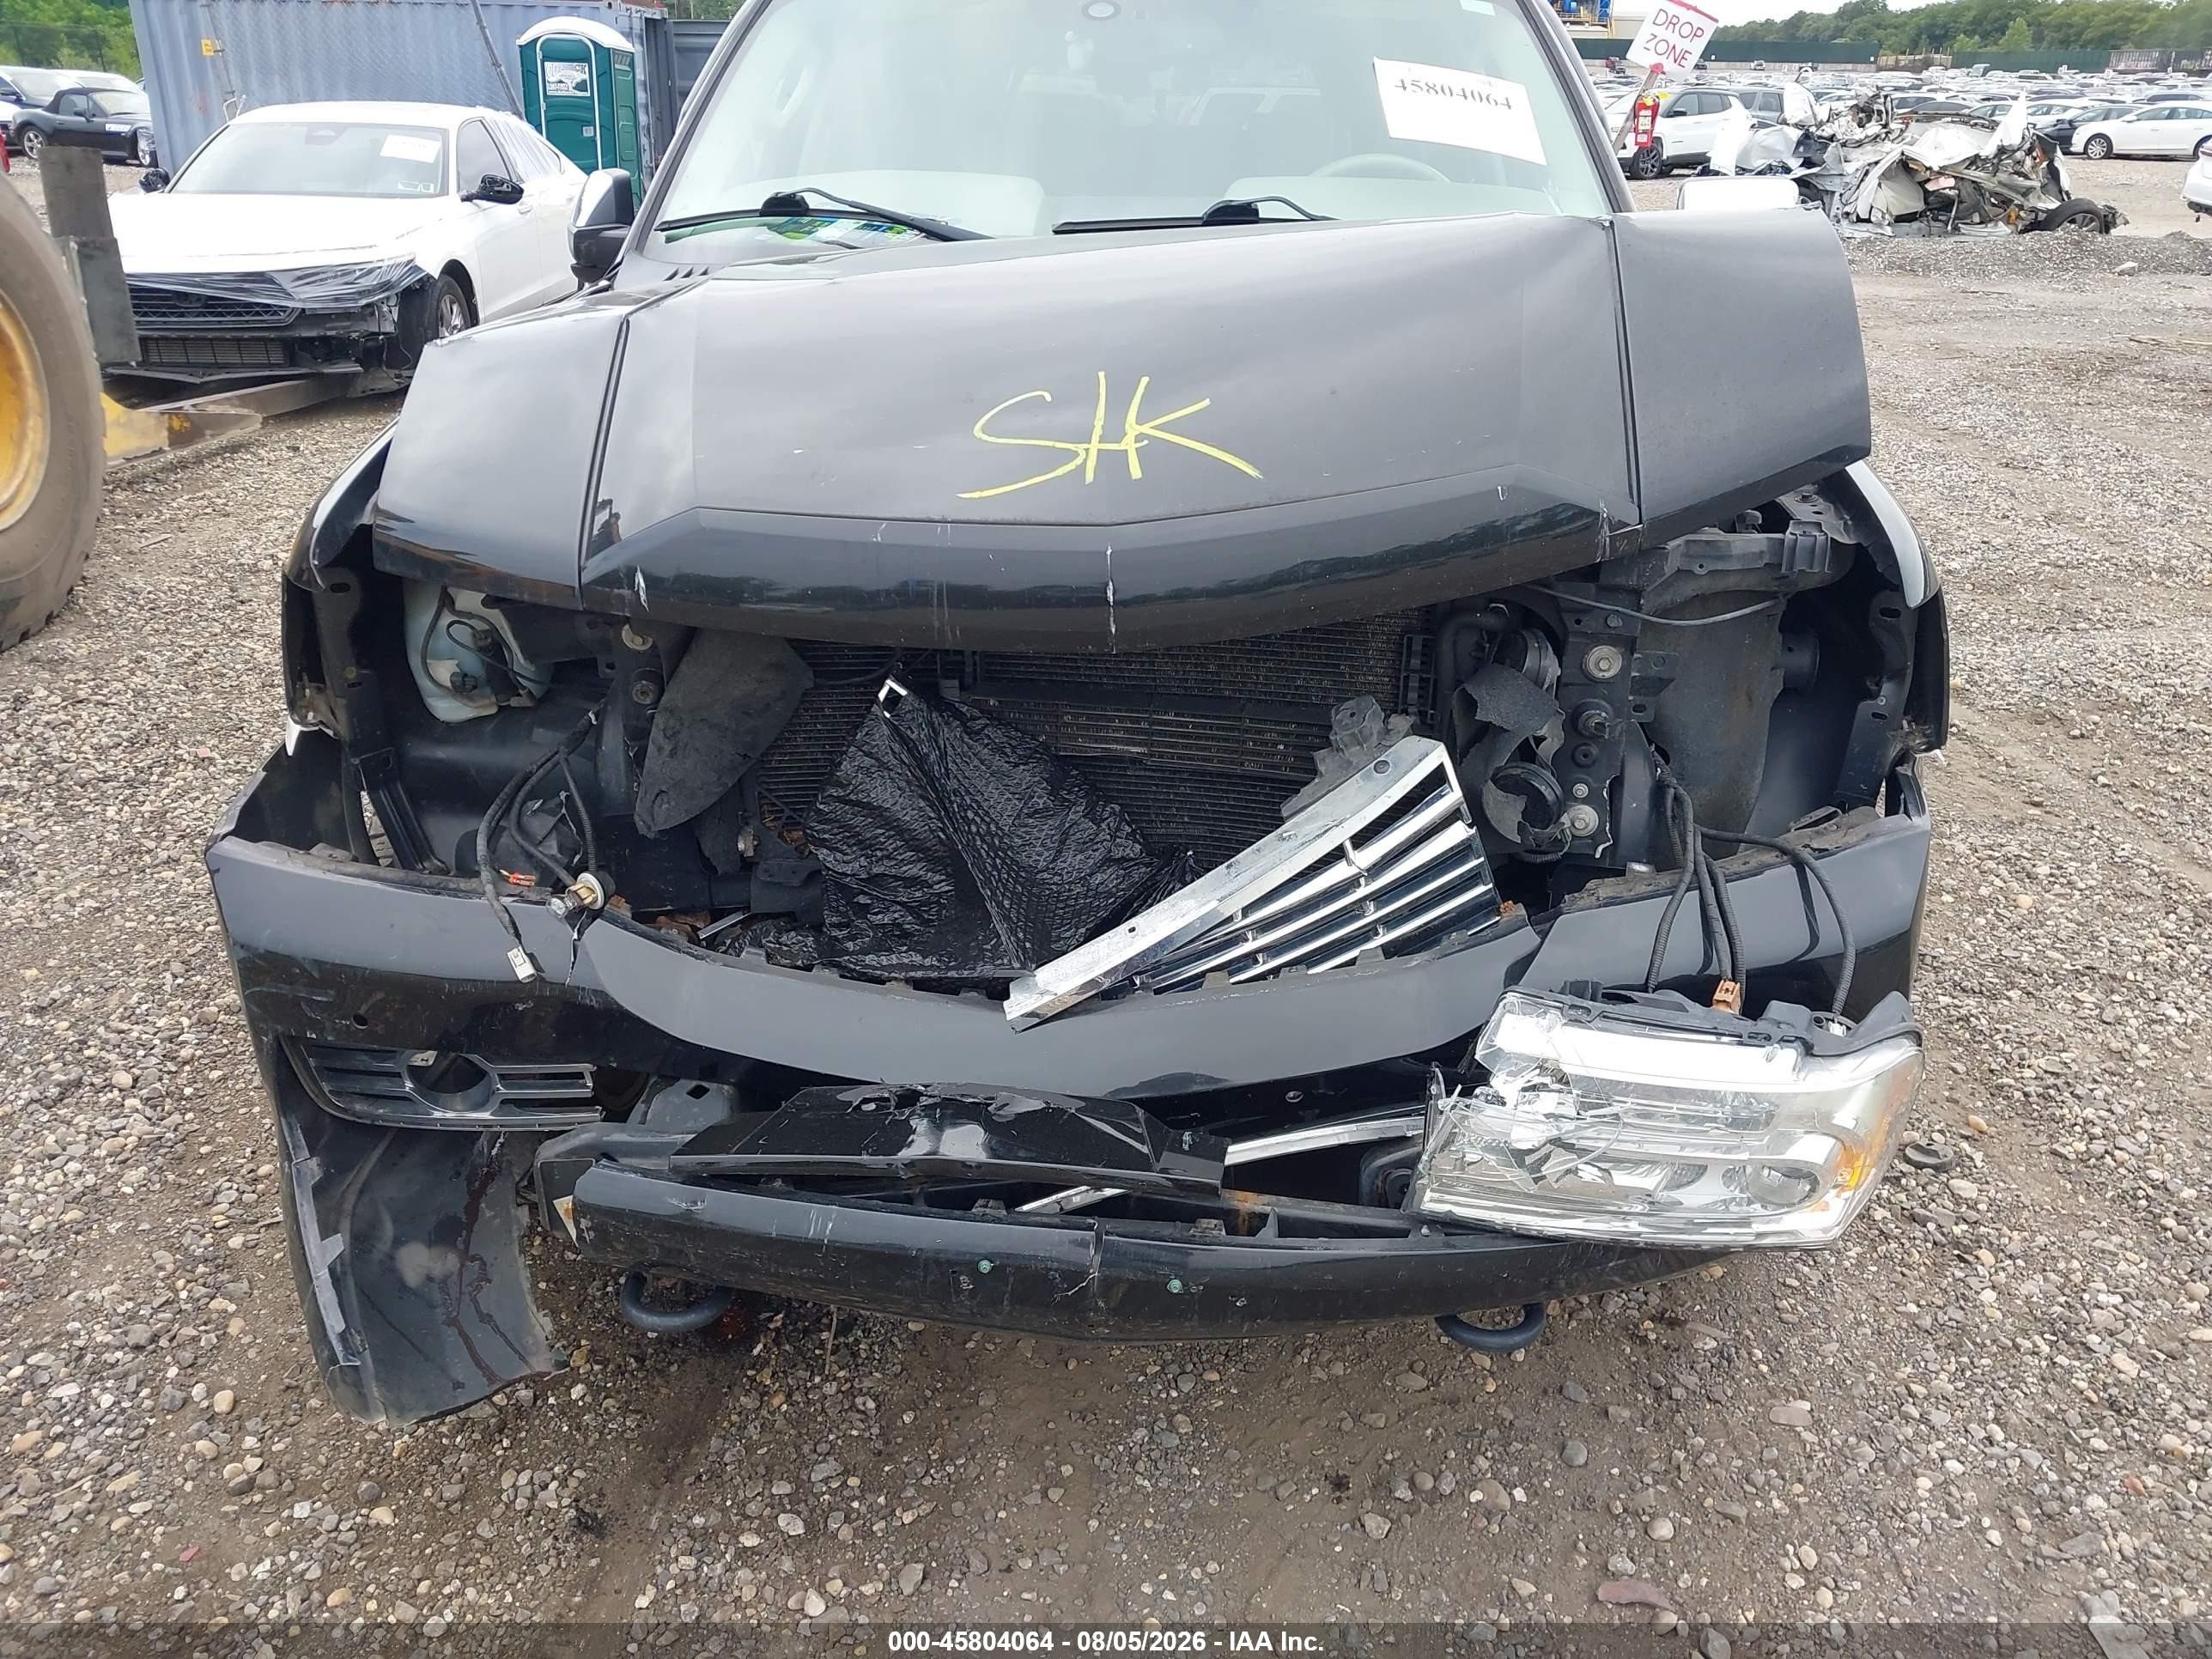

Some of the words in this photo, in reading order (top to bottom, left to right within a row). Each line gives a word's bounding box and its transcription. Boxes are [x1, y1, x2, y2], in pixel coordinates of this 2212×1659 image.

[1652, 8, 1705, 43] DROP
[1644, 33, 1692, 69] ZONE
[1394, 78, 1512, 110] 45804064
